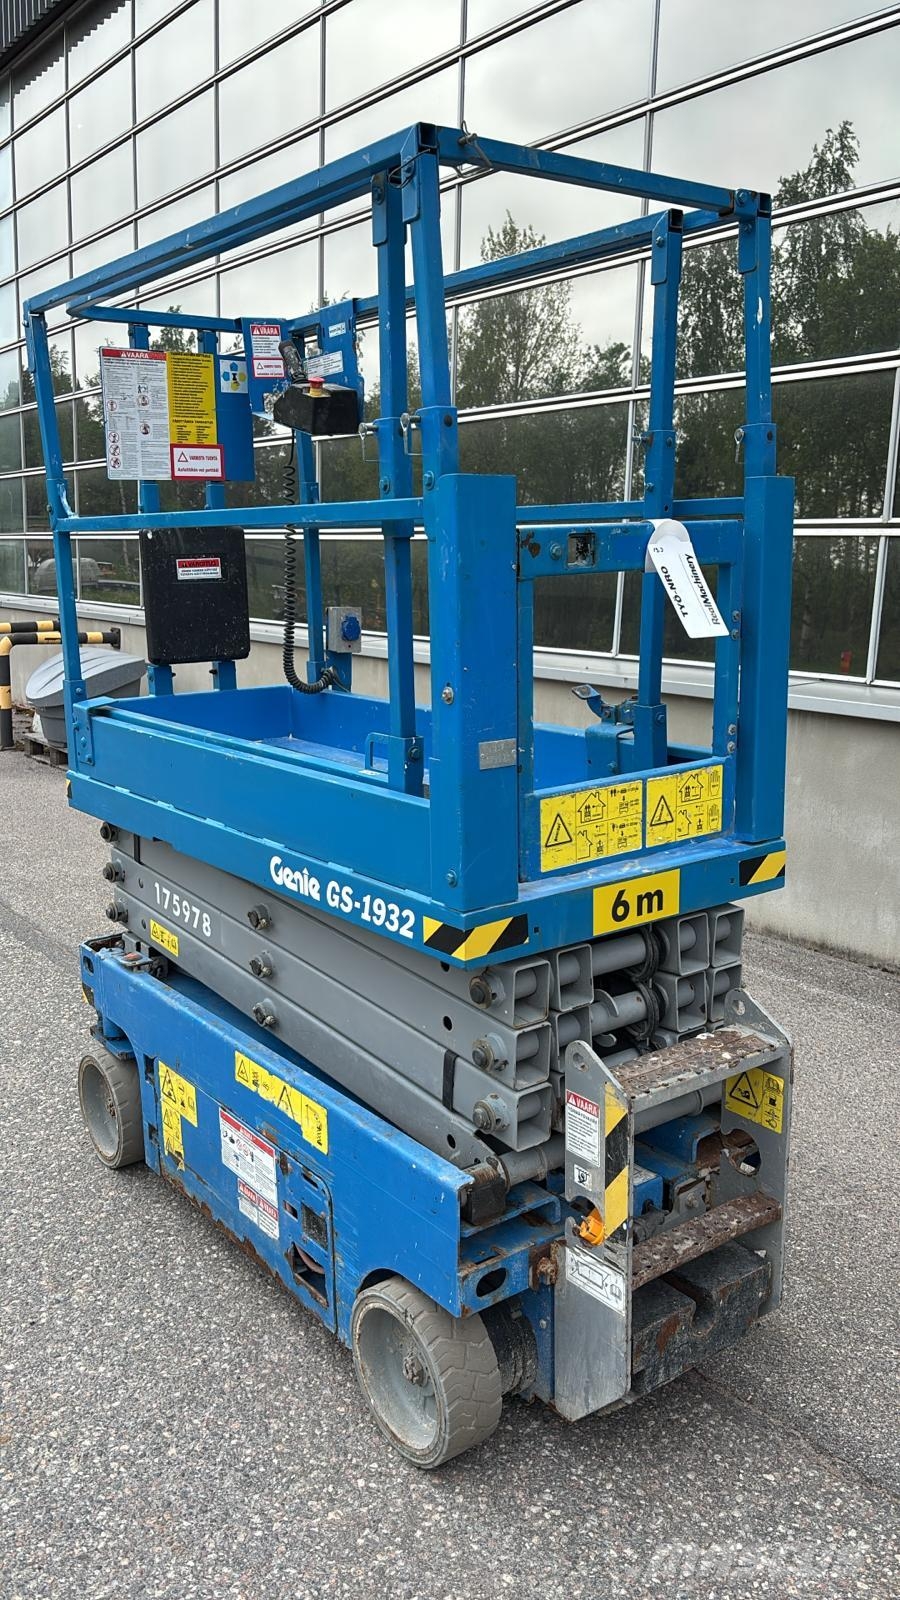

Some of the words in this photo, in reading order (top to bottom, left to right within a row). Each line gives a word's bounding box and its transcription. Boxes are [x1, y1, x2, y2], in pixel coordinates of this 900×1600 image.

[260, 326, 279, 335] VAARA
[126, 351, 149, 359] VAARA
[685, 553, 721, 625] RealMachinery
[154, 882, 212, 937] 175978
[269, 855, 321, 902] Genie
[326, 880, 416, 940] GS-1932
[611, 888, 630, 923] 6
[636, 887, 664, 917] m
[576, 1095, 598, 1116] VAARA
